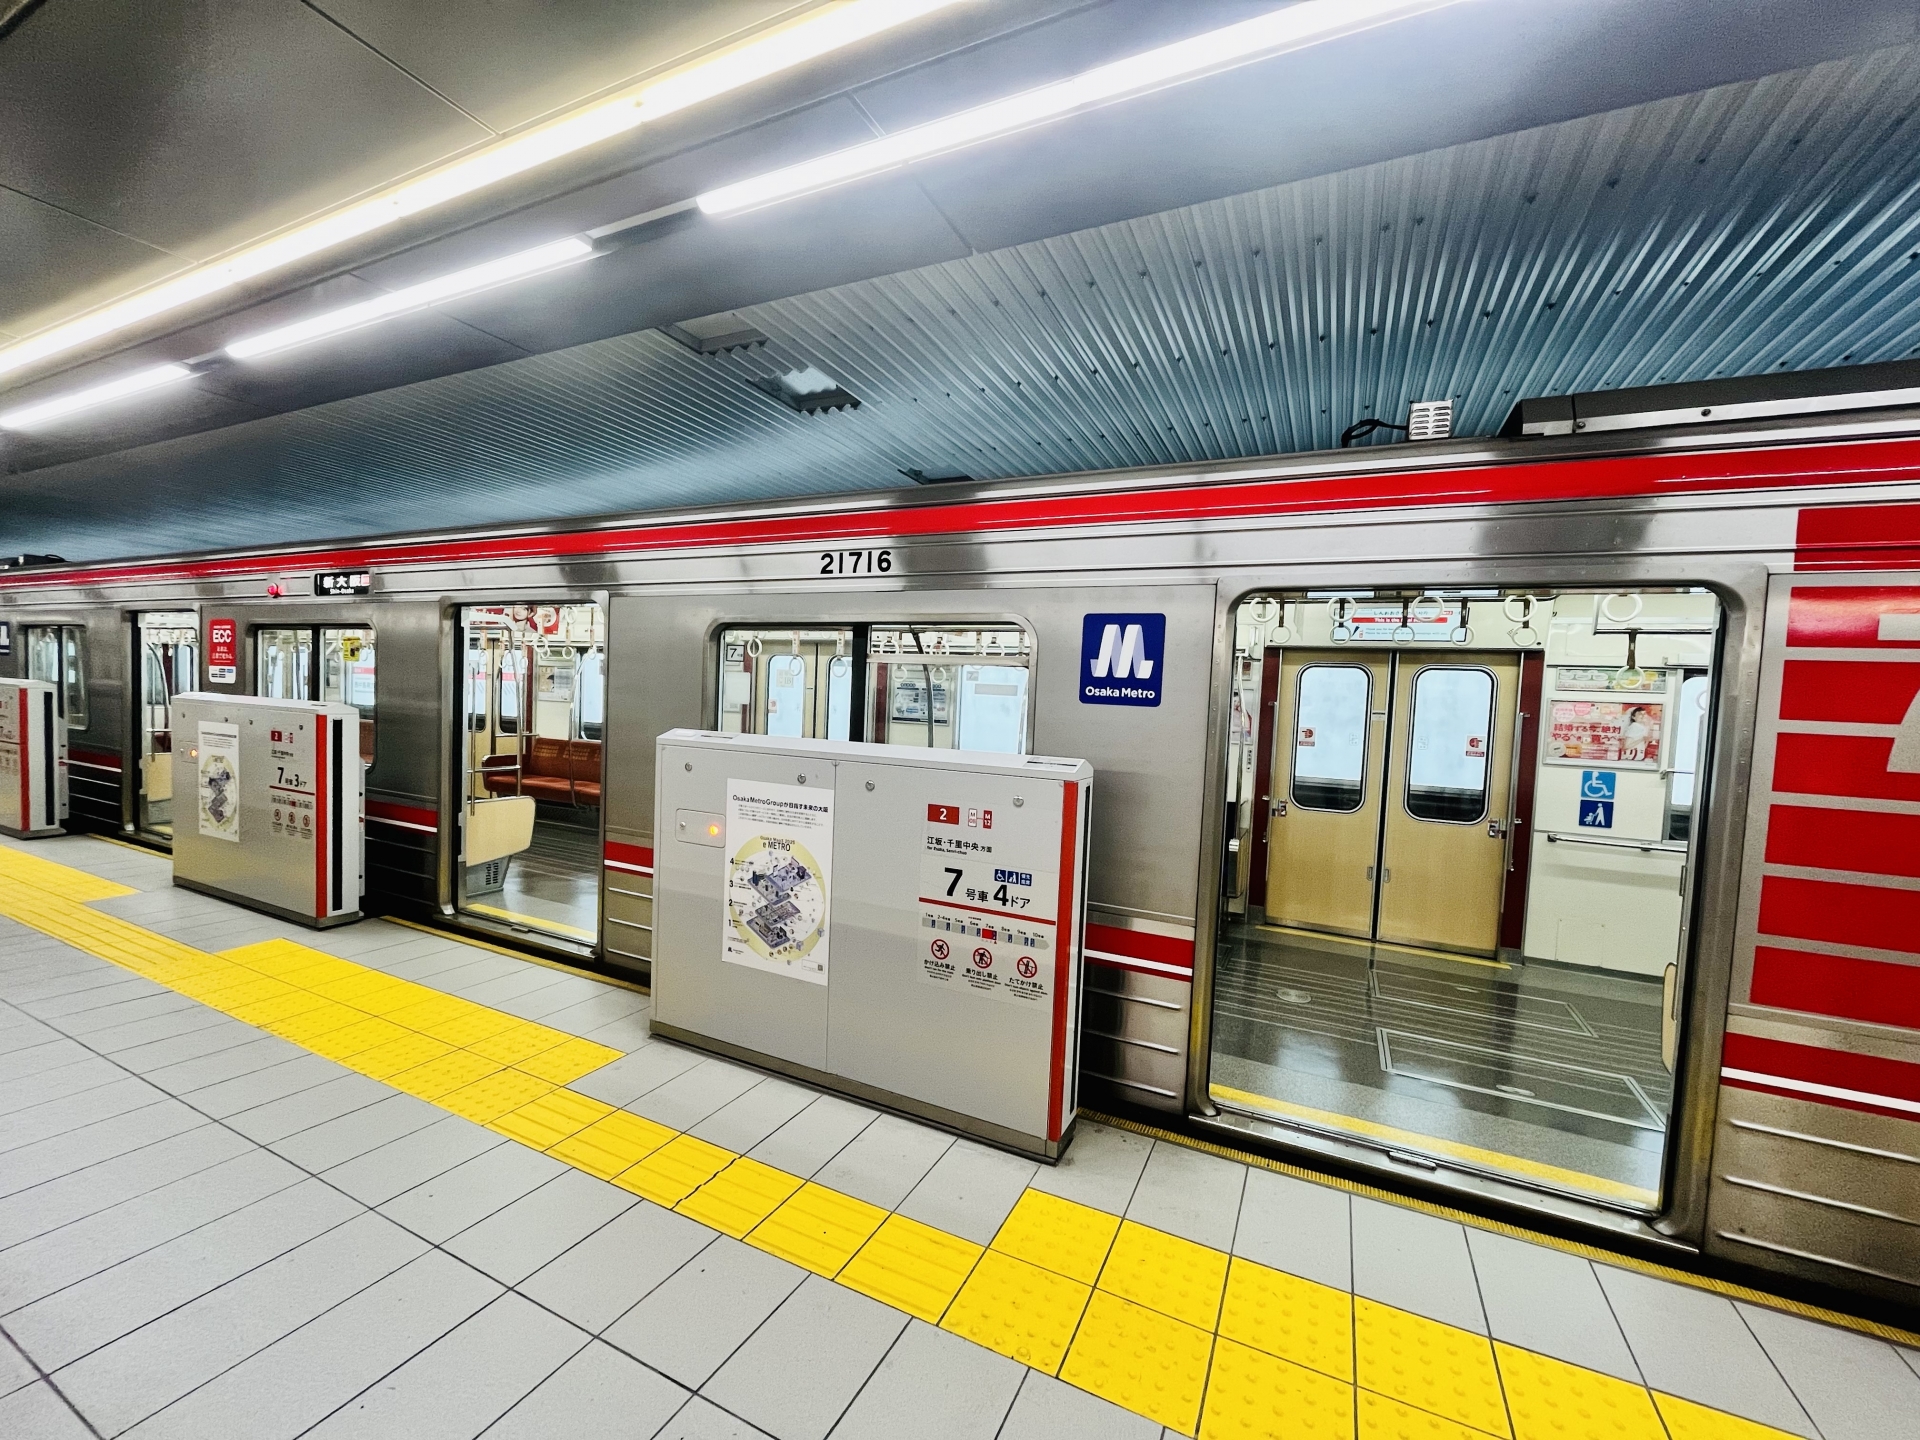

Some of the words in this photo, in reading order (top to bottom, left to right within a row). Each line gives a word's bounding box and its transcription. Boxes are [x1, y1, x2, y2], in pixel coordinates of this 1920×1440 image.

[820, 550, 892, 575] 21716
[213, 630, 232, 643] ECC
[1085, 686, 1120, 697] Osaka
[1121, 687, 1156, 699] Metro
[939, 808, 947, 820] 2
[767, 841, 791, 852] METRO
[729, 857, 735, 865] 4
[729, 880, 734, 888] 3
[728, 899, 733, 907] 2
